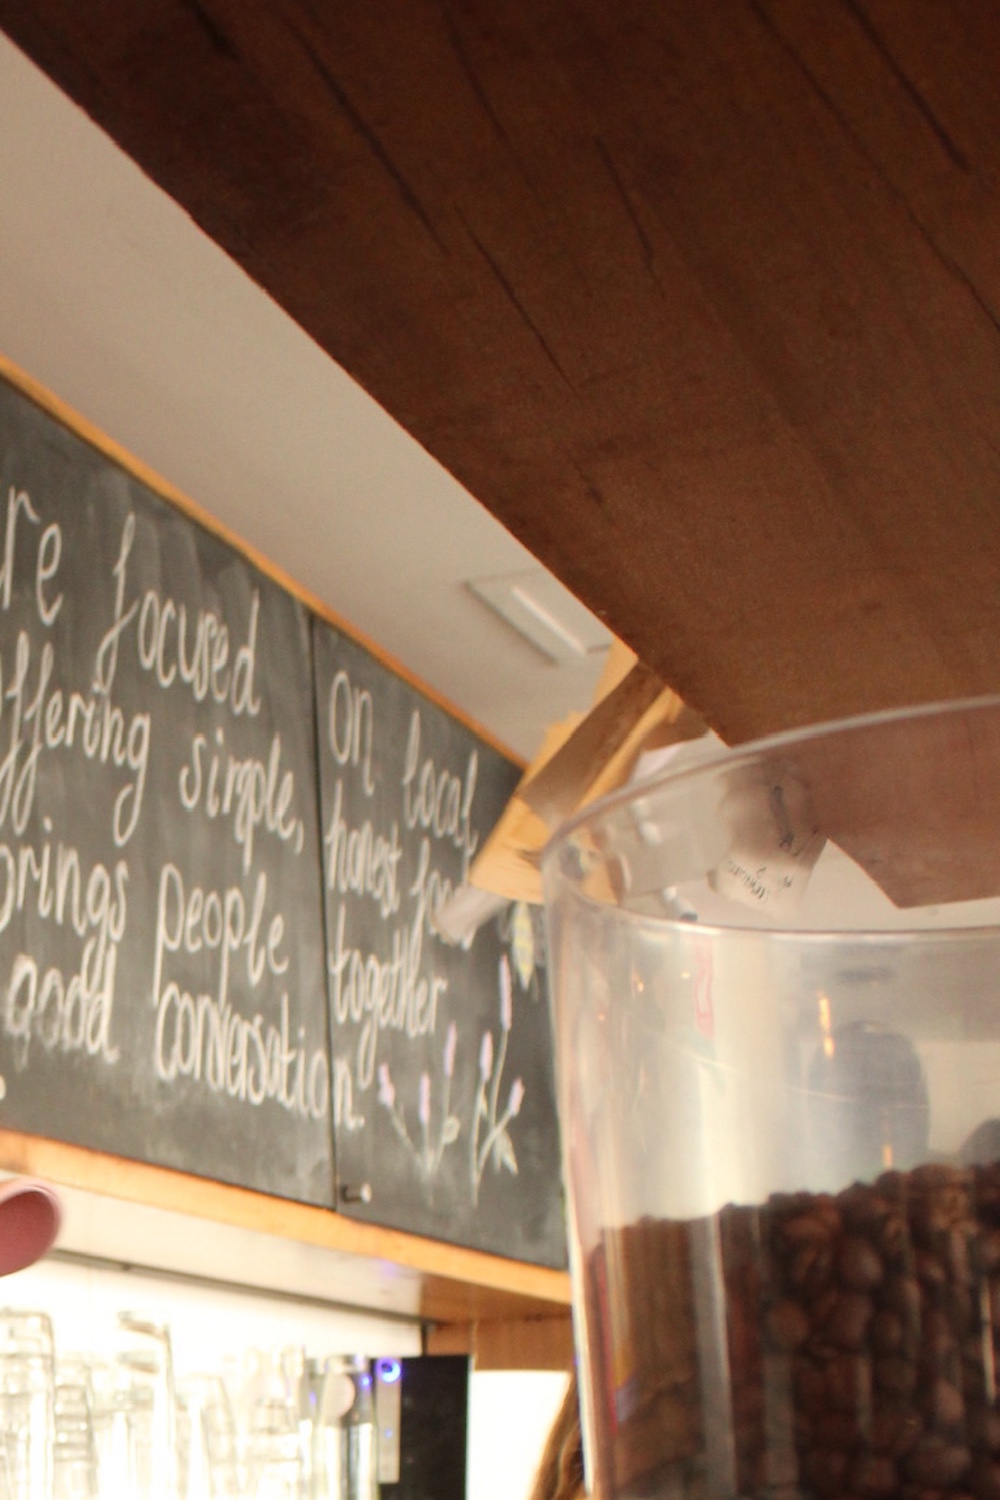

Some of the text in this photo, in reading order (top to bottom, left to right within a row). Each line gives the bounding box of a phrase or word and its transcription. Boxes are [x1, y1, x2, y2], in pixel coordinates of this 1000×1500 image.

[91, 510, 262, 717] focused
[329, 669, 376, 797] on
[402, 707, 480, 858] local
[152, 862, 290, 1009] people
[328, 901, 448, 1091] together
[178, 727, 305, 875] simple,
[324, 776, 403, 920] honest
[408, 836, 479, 985] fo
[4, 942, 122, 1070] good
